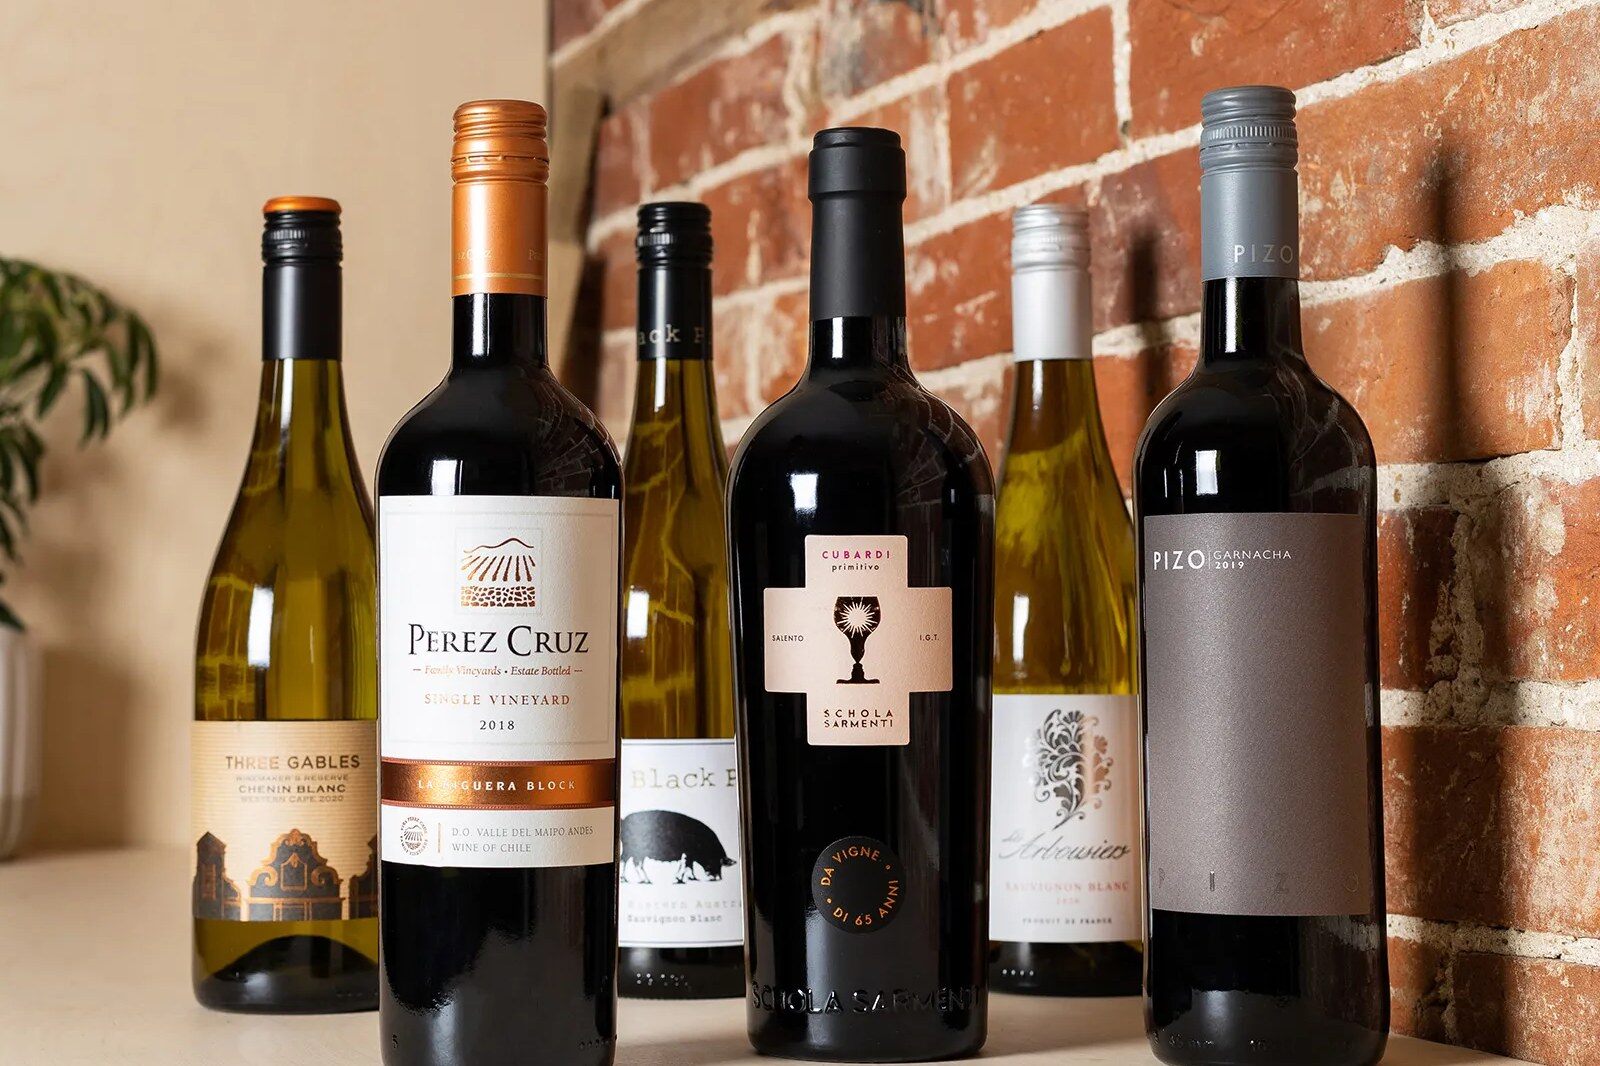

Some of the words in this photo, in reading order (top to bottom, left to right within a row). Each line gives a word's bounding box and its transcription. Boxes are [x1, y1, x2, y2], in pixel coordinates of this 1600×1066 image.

[1234, 244, 1294, 264] PIZO
[822, 550, 890, 559] CUBARDI
[1153, 549, 1206, 570] PIZO
[1213, 549, 1292, 560] GARNACHA
[831, 562, 880, 573] primitivo
[1215, 561, 1245, 570] 2019
[408, 623, 498, 655] PEREZ
[507, 625, 589, 657] CRUZ
[771, 634, 805, 642] SALENTO
[455, 665, 501, 678] Vineyards
[510, 666, 540, 676] Estate
[541, 665, 571, 676] Bottled
[489, 694, 570, 706] VINEYARD
[824, 709, 894, 718] SCHOLA
[479, 720, 515, 730] 2018
[824, 719, 894, 728] SARMENTI
[225, 756, 279, 770] THREE
[287, 754, 360, 770] GABLES
[630, 767, 716, 789] Black
[238, 785, 291, 793] CHENIN
[296, 784, 346, 793] BLANC
[418, 780, 433, 789] LA
[442, 781, 517, 791] GUERA
[527, 780, 575, 791] BLOCK
[289, 795, 314, 803] CAPE
[319, 795, 344, 803] 2020
[452, 827, 473, 837] D.O.
[476, 828, 508, 837] VALLE
[511, 828, 532, 837] DEL
[534, 827, 566, 837] MAIPO
[567, 825, 594, 836] ANDES
[451, 843, 479, 852] WINE
[482, 843, 497, 852] OF
[500, 843, 532, 853] CHILE
[820, 867, 835, 886] DA
[832, 846, 881, 863] VIGNE
[1087, 880, 1130, 891] BLANC
[833, 907, 849, 922] DI
[855, 914, 873, 926] 65
[878, 880, 900, 919] ANNI
[751, 981, 844, 1015] SCHOLA
